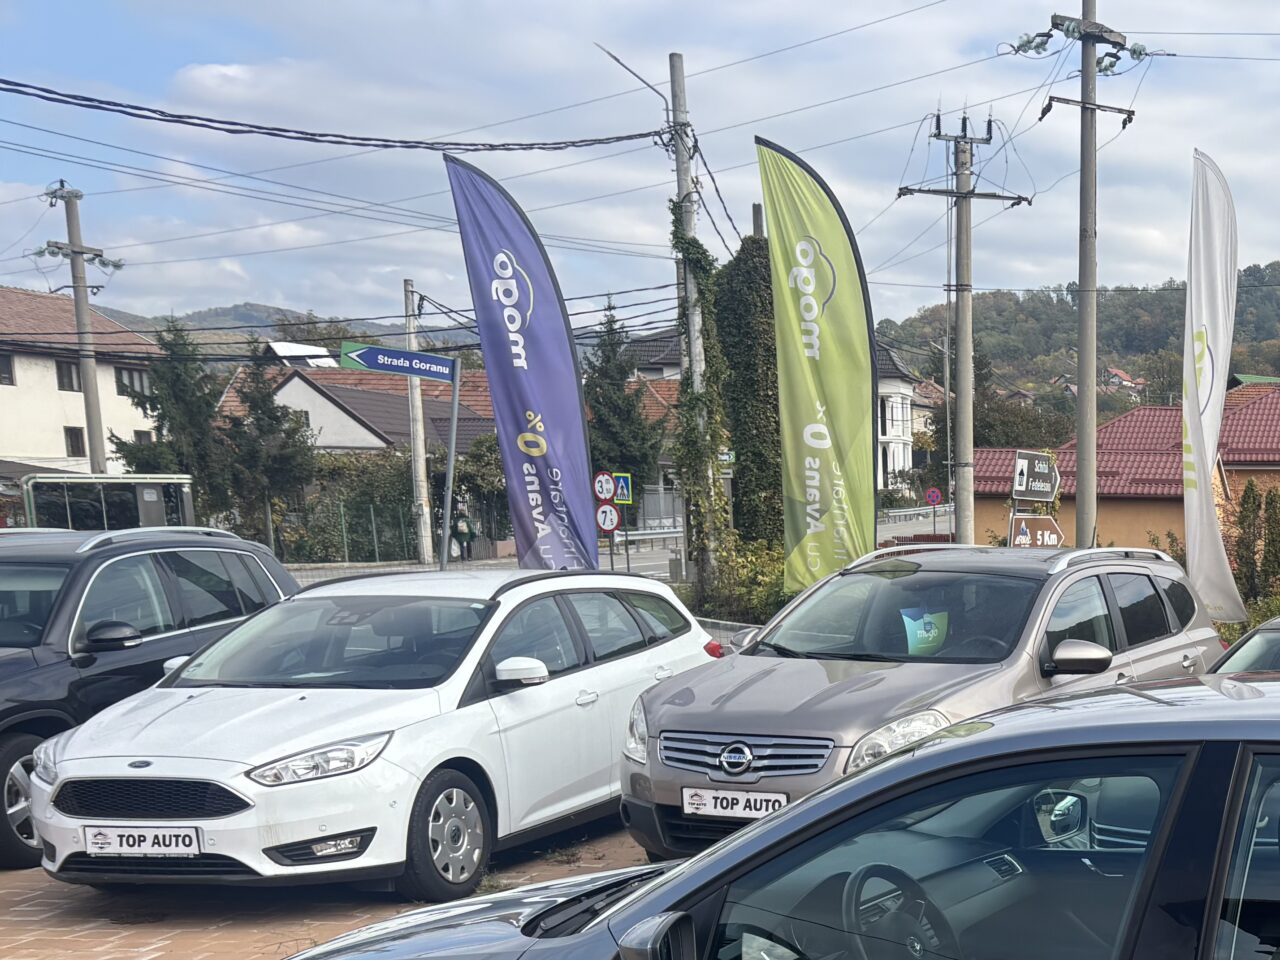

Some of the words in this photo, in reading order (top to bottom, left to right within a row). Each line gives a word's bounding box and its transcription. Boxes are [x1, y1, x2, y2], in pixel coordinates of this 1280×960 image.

[377, 354, 410, 367] Strada
[412, 359, 449, 374] Goranu
[1036, 530, 1042, 546] 5
[1043, 530, 1058, 546] Km
[712, 796, 740, 810] TOP
[743, 797, 782, 812] AUTO
[117, 834, 147, 848] TOP
[151, 834, 193, 848] AUTO
